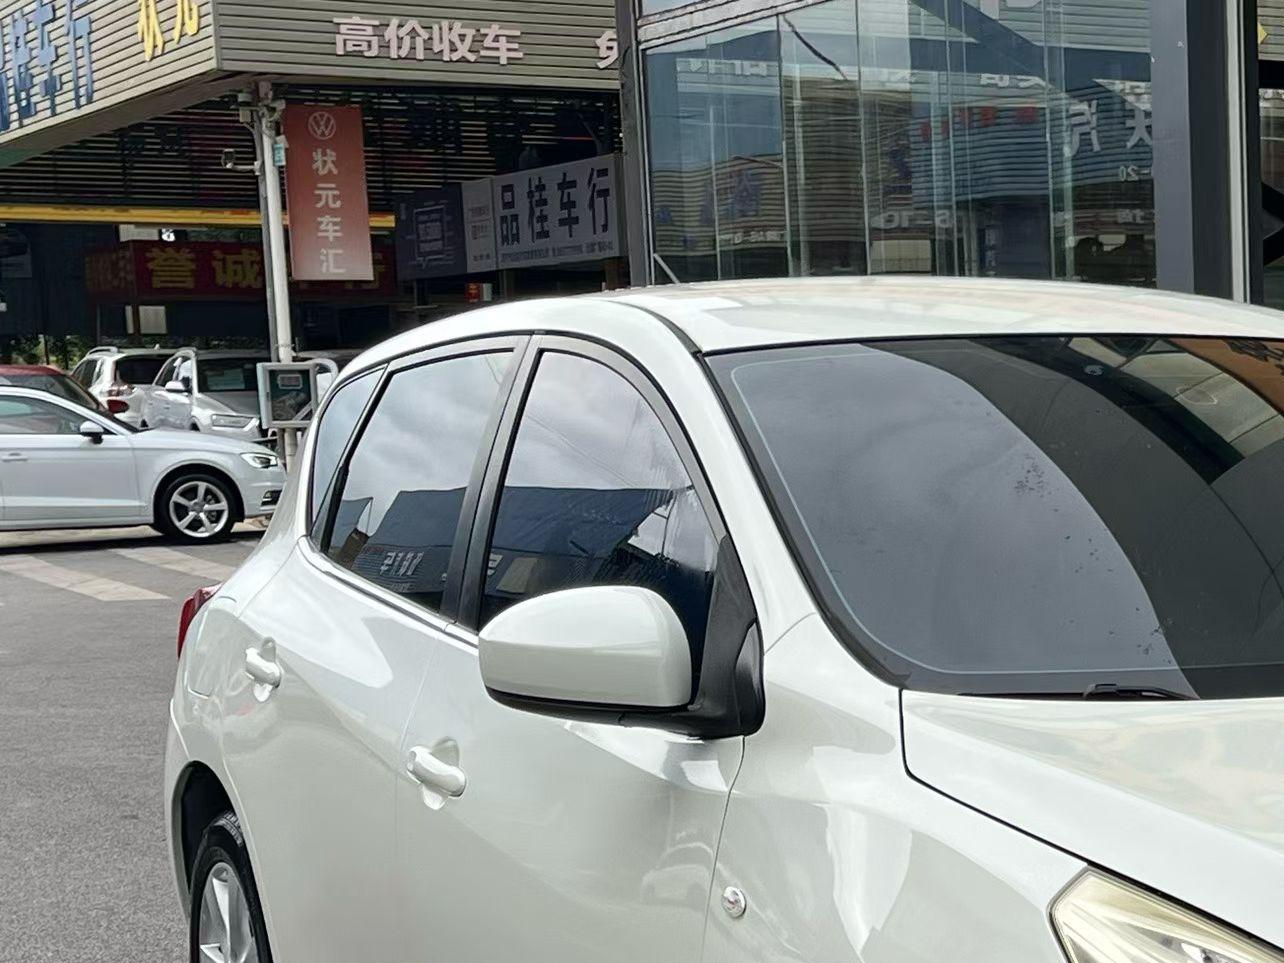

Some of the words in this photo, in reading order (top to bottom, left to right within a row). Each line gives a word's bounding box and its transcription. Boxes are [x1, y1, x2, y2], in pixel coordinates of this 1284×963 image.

[333, 16, 524, 65] 高价收车
[312, 149, 346, 273] 状元车汇
[501, 168, 611, 245] 品桂车行
